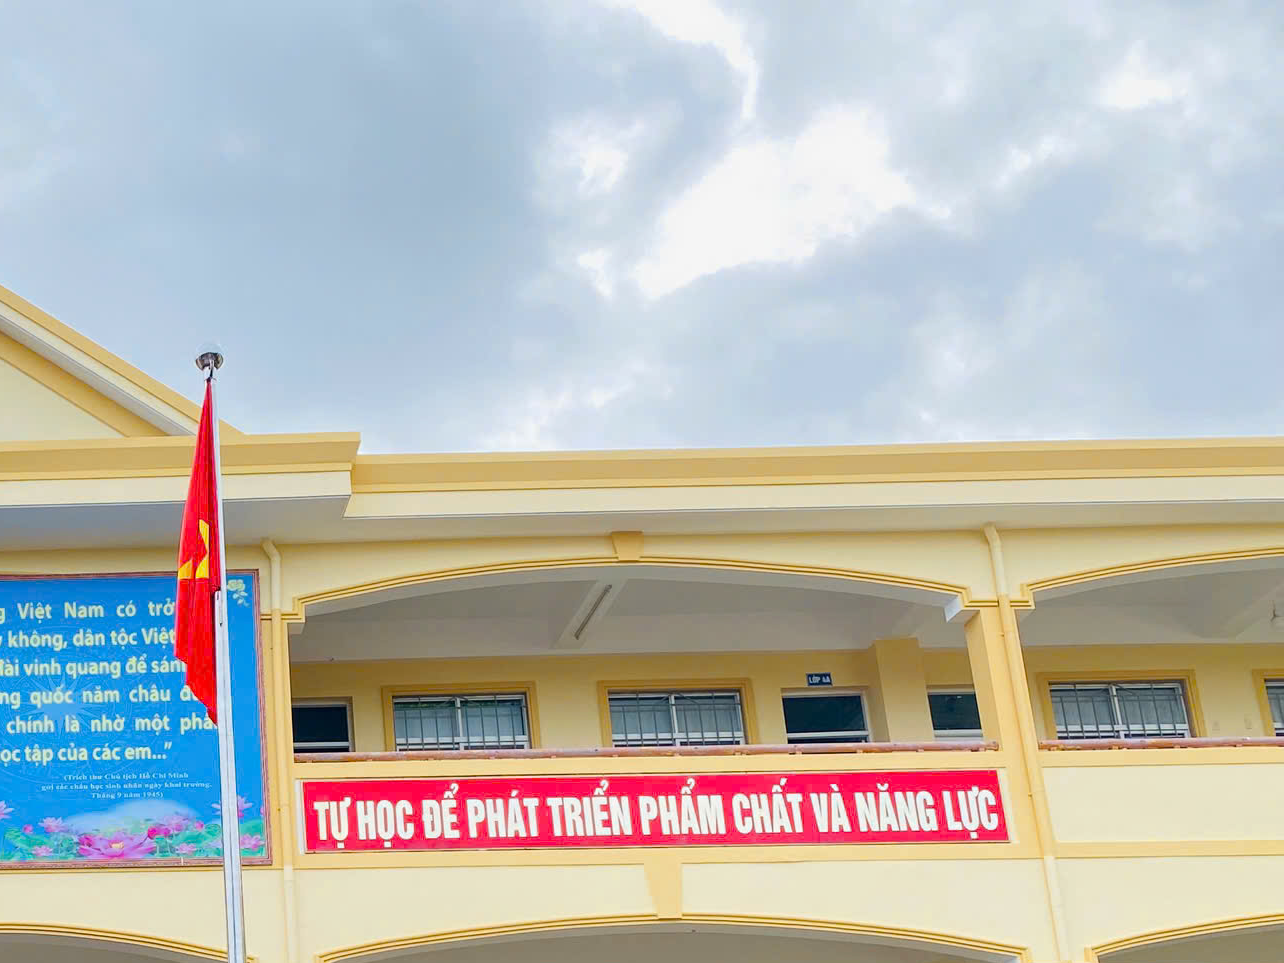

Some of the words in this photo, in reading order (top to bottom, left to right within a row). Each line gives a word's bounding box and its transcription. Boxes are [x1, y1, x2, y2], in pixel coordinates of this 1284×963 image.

[17, 602, 52, 624] Việt
[64, 602, 105, 618] Nam
[116, 600, 137, 618] có
[148, 598, 176, 617] trở
[7, 630, 68, 652] không,
[72, 629, 106, 646] dân
[110, 627, 137, 650] tộc
[141, 627, 176, 649] Việt
[23, 658, 61, 676] vinh
[66, 660, 121, 679] quang
[125, 653, 147, 673] để
[30, 683, 73, 709] quốc
[82, 686, 120, 703] năm
[129, 683, 171, 702] châu
[6, 715, 55, 734] chính
[65, 714, 80, 733] là
[90, 714, 125, 732] nhờ
[134, 713, 170, 735] một
[24, 743, 54, 767] tập
[57, 742, 88, 762] của
[92, 743, 121, 761] các
[313, 797, 351, 849] TỰ
[356, 799, 414, 848] HỌC
[421, 783, 460, 839] ĐỂ
[466, 790, 539, 839] PHÁT
[546, 780, 633, 838] TRIỂN
[638, 778, 726, 836] PHẨM
[731, 777, 804, 835] CHẤT
[809, 784, 852, 833] VÀ
[854, 783, 939, 833] NĂNG
[942, 786, 999, 840] LỰC
